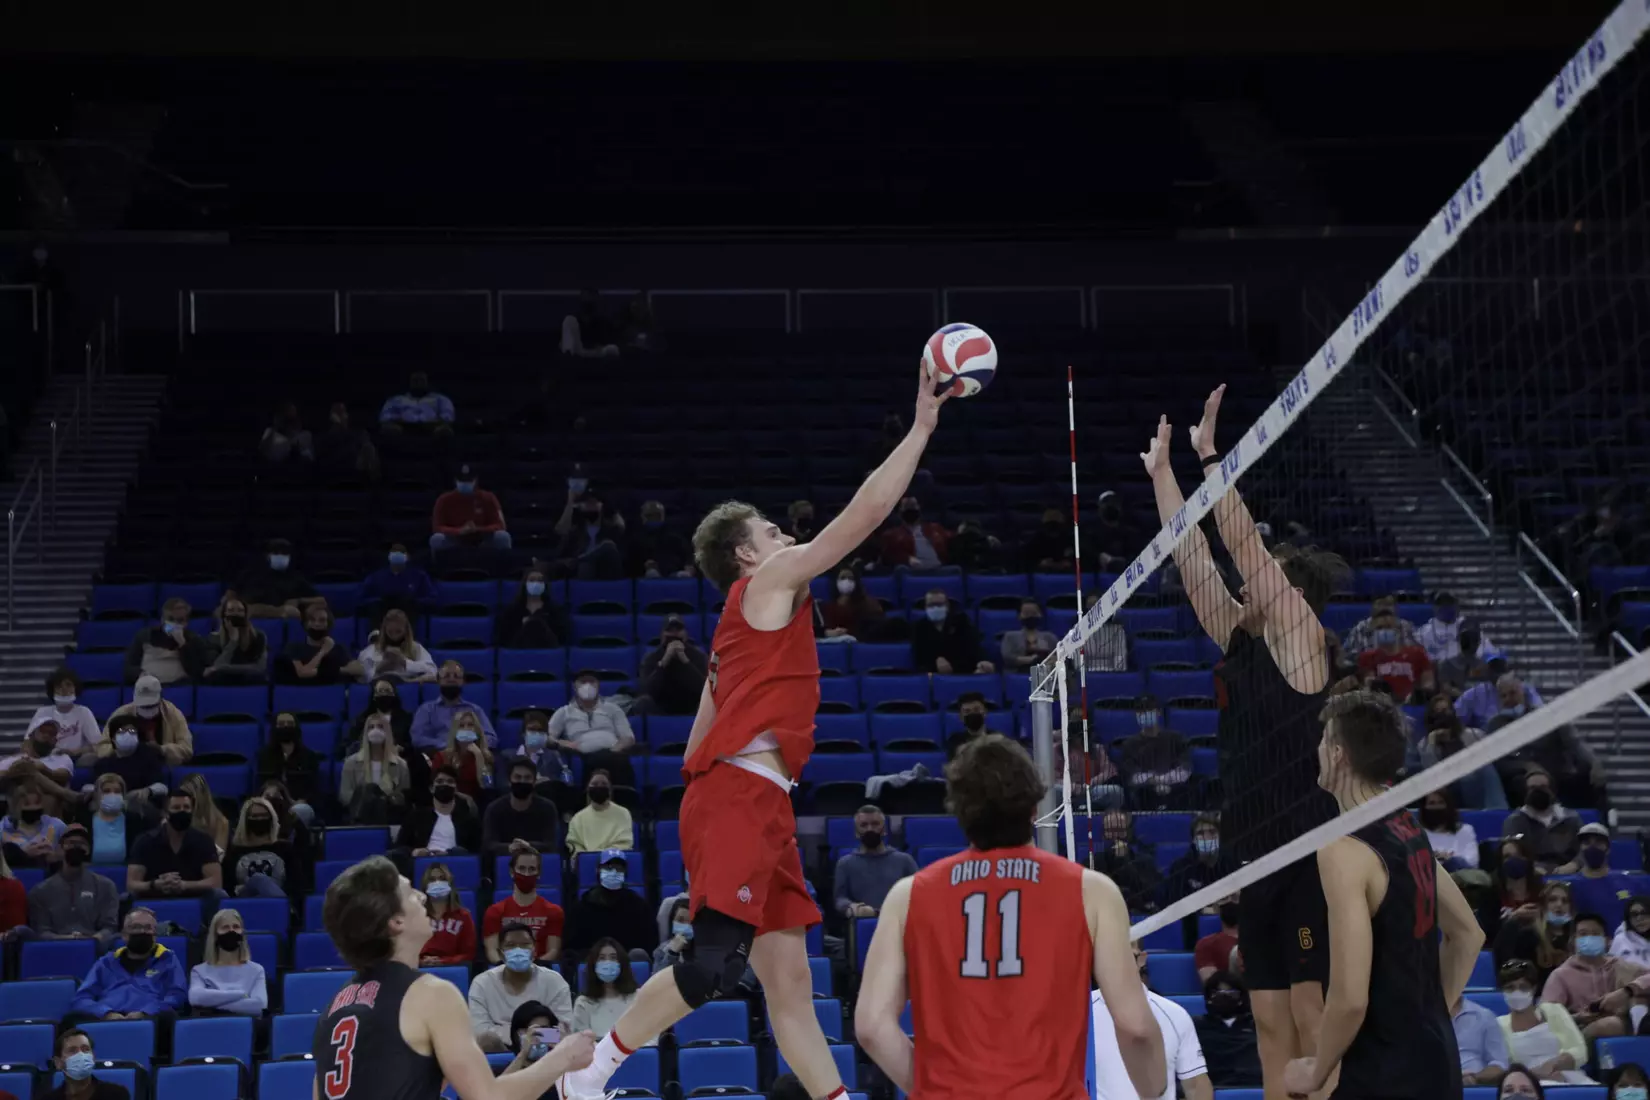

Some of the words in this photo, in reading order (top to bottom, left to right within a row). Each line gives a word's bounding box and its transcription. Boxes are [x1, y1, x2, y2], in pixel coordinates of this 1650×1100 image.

[951, 859, 991, 886] OHIO
[996, 857, 1040, 884] STATE
[960, 889, 1023, 980] 11
[1298, 927, 1314, 950] 6
[325, 1015, 359, 1100] 3
